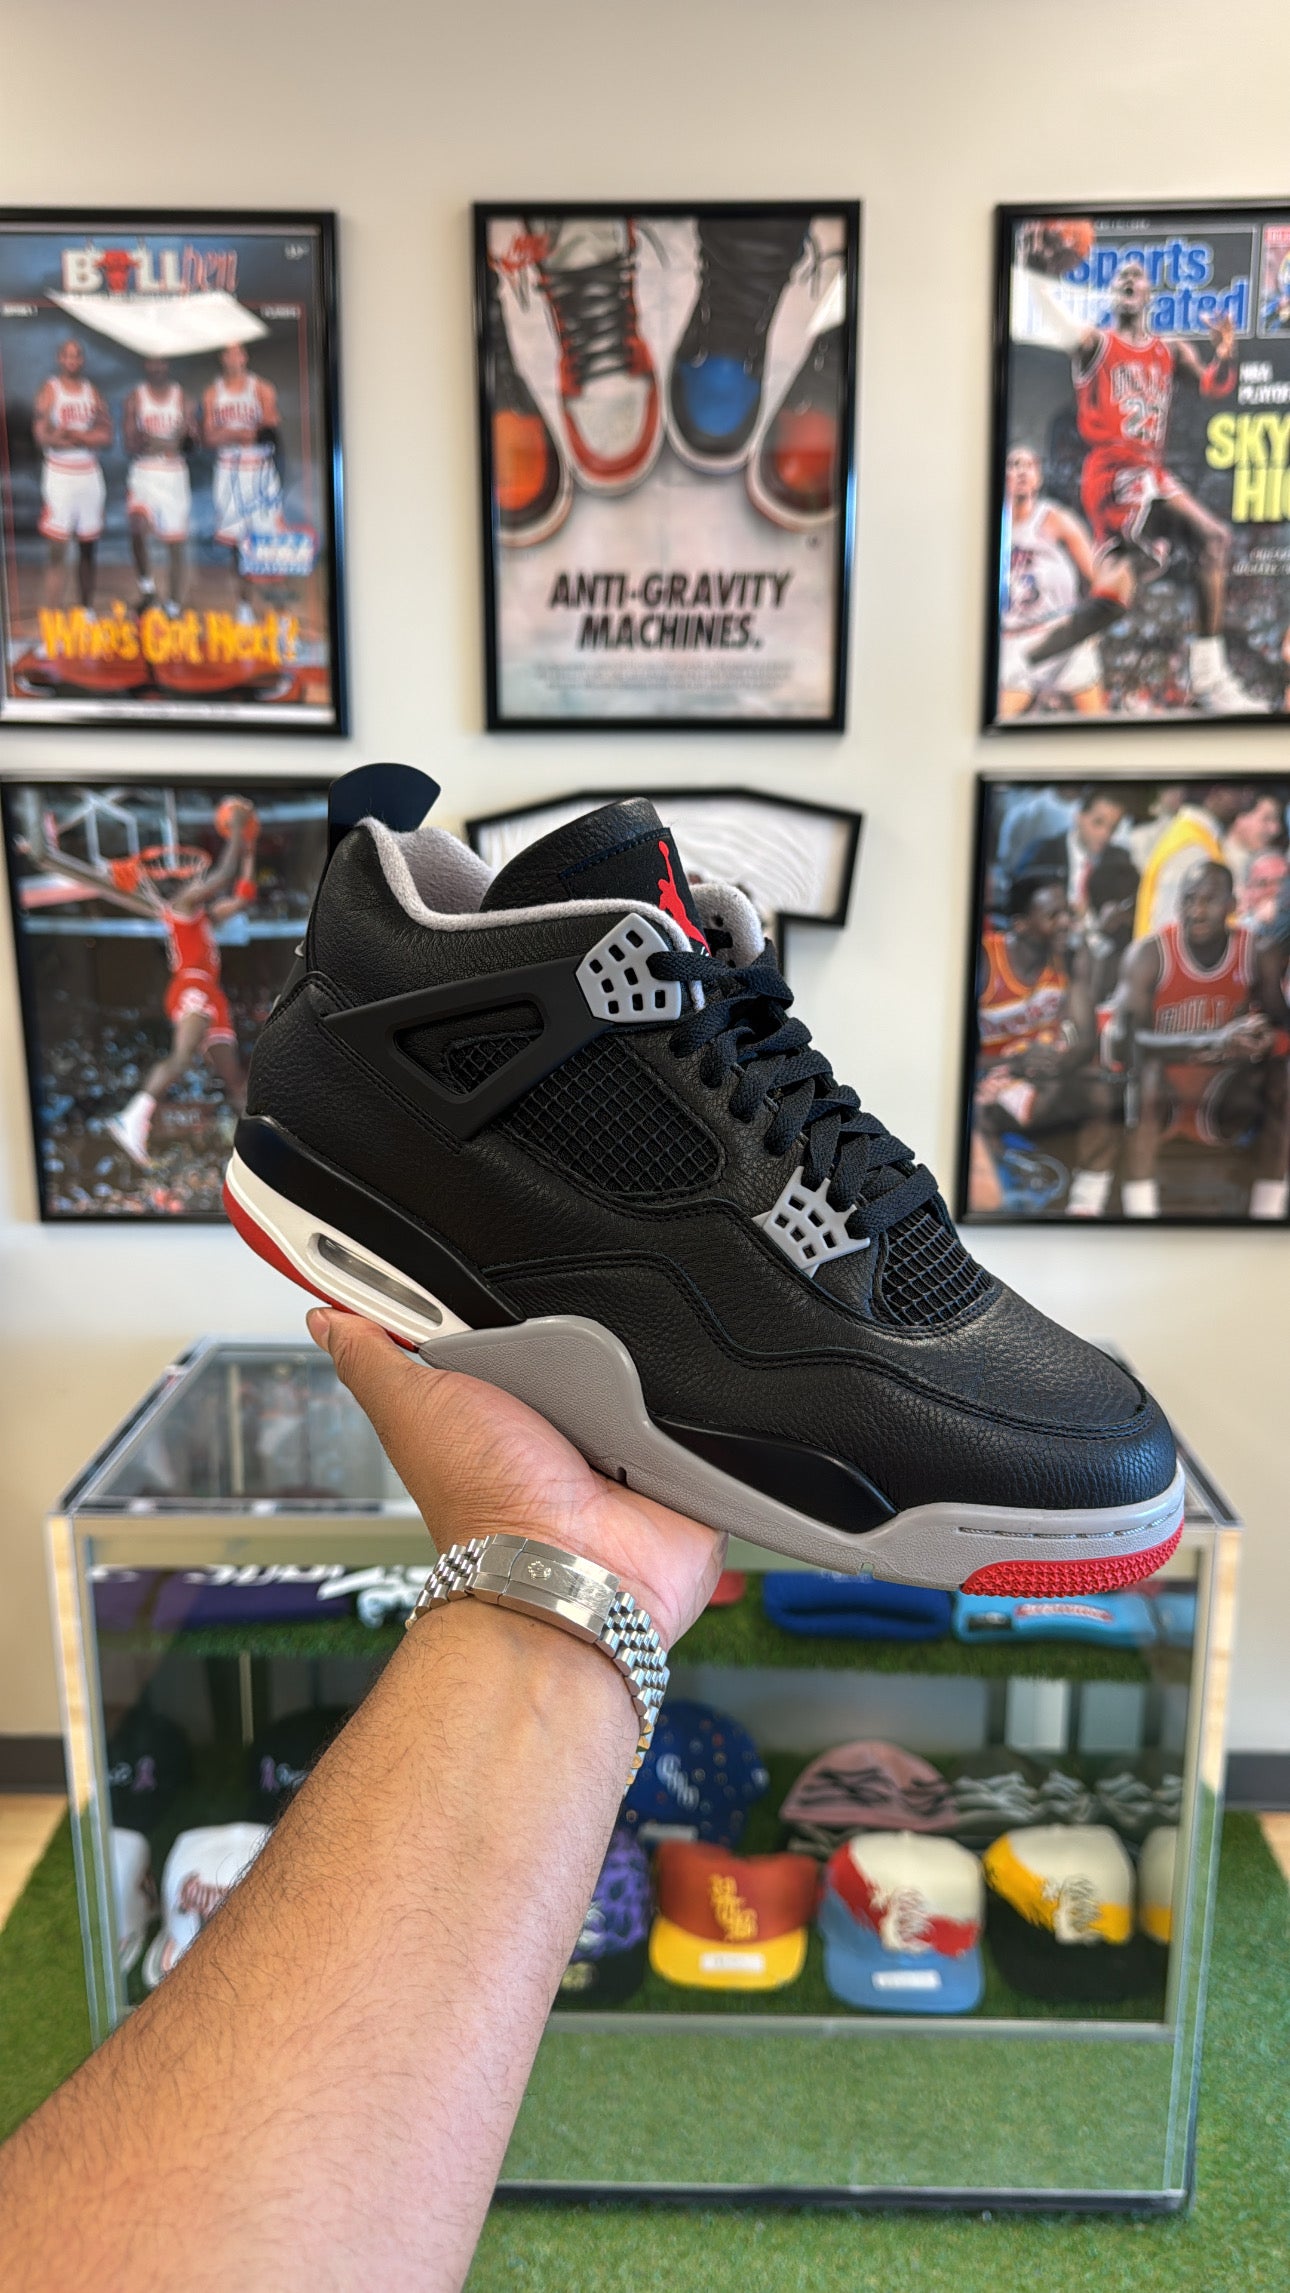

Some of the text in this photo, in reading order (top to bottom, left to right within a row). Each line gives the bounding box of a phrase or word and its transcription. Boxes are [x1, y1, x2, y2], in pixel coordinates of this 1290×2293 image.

[1205, 411, 1290, 470] SKY
[1232, 467, 1290, 522] HI
[549, 571, 793, 608] ANTI-GRAVITY
[141, 607, 202, 665] Got
[577, 612, 763, 650] MACHINES.
